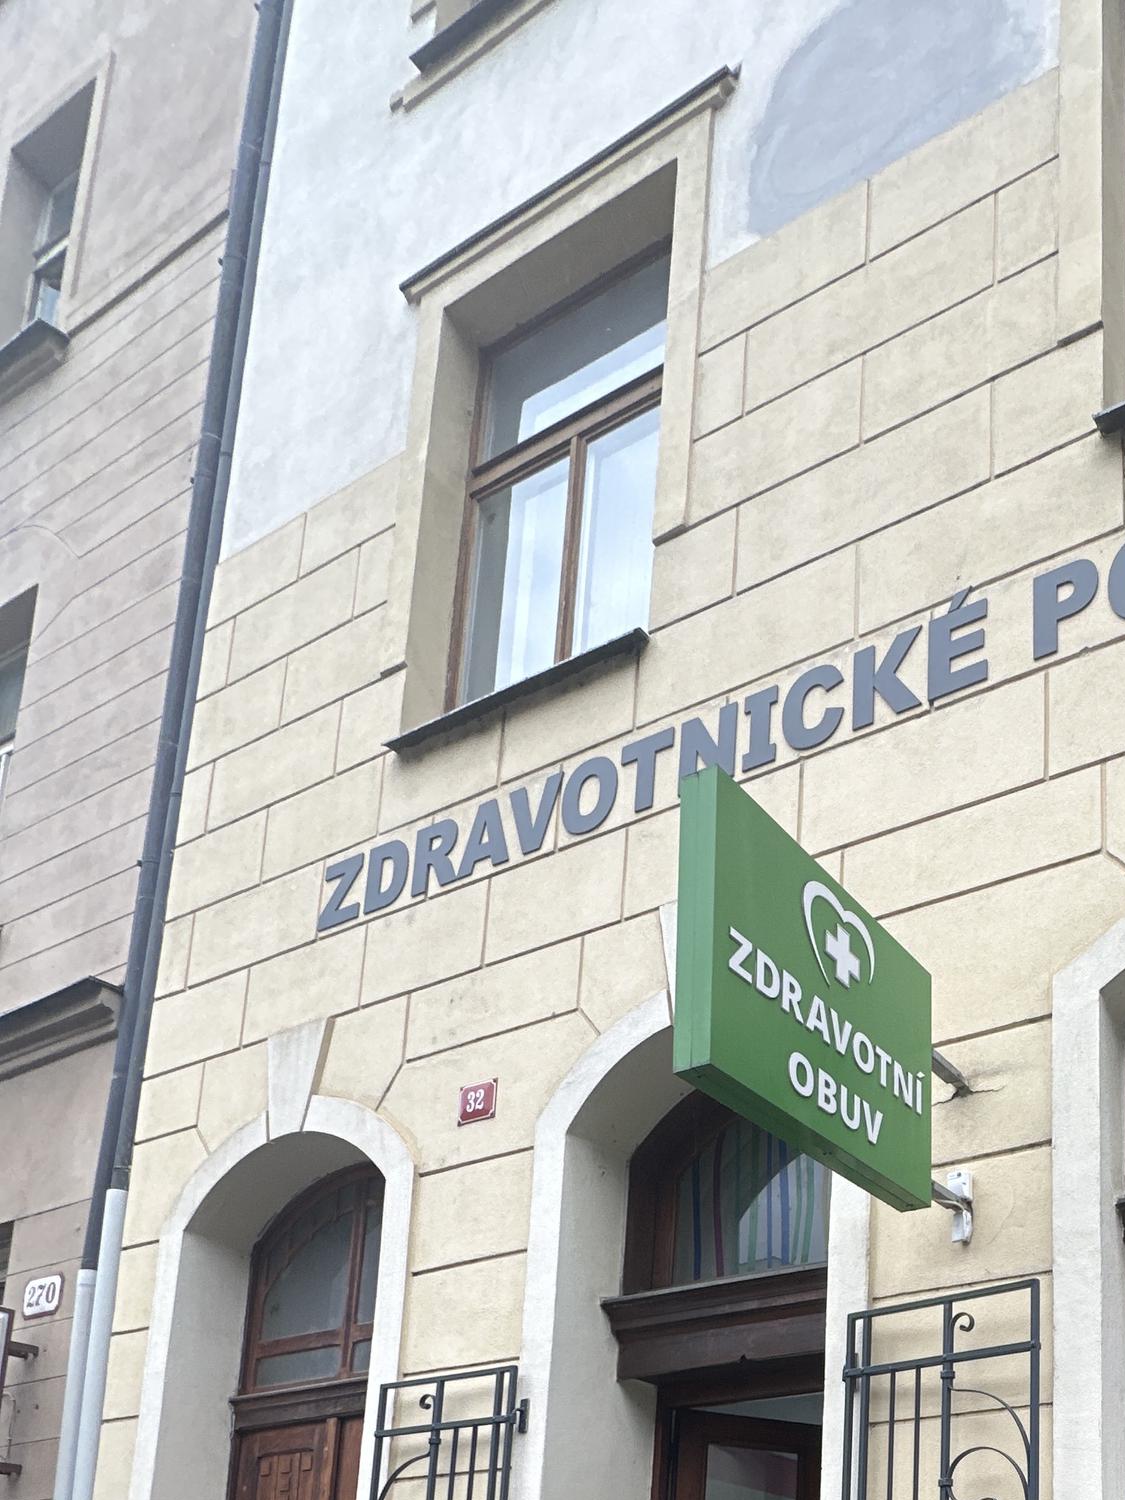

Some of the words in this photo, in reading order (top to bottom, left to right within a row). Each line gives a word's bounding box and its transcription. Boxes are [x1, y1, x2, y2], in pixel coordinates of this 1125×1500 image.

[316, 586, 988, 932] ZDRAVOTNICKÉ
[727, 926, 926, 1116] ZDRAVOTNÍ
[466, 1088, 485, 1113] 32
[787, 1051, 884, 1145] OBUV
[26, 1281, 56, 1308] 270
